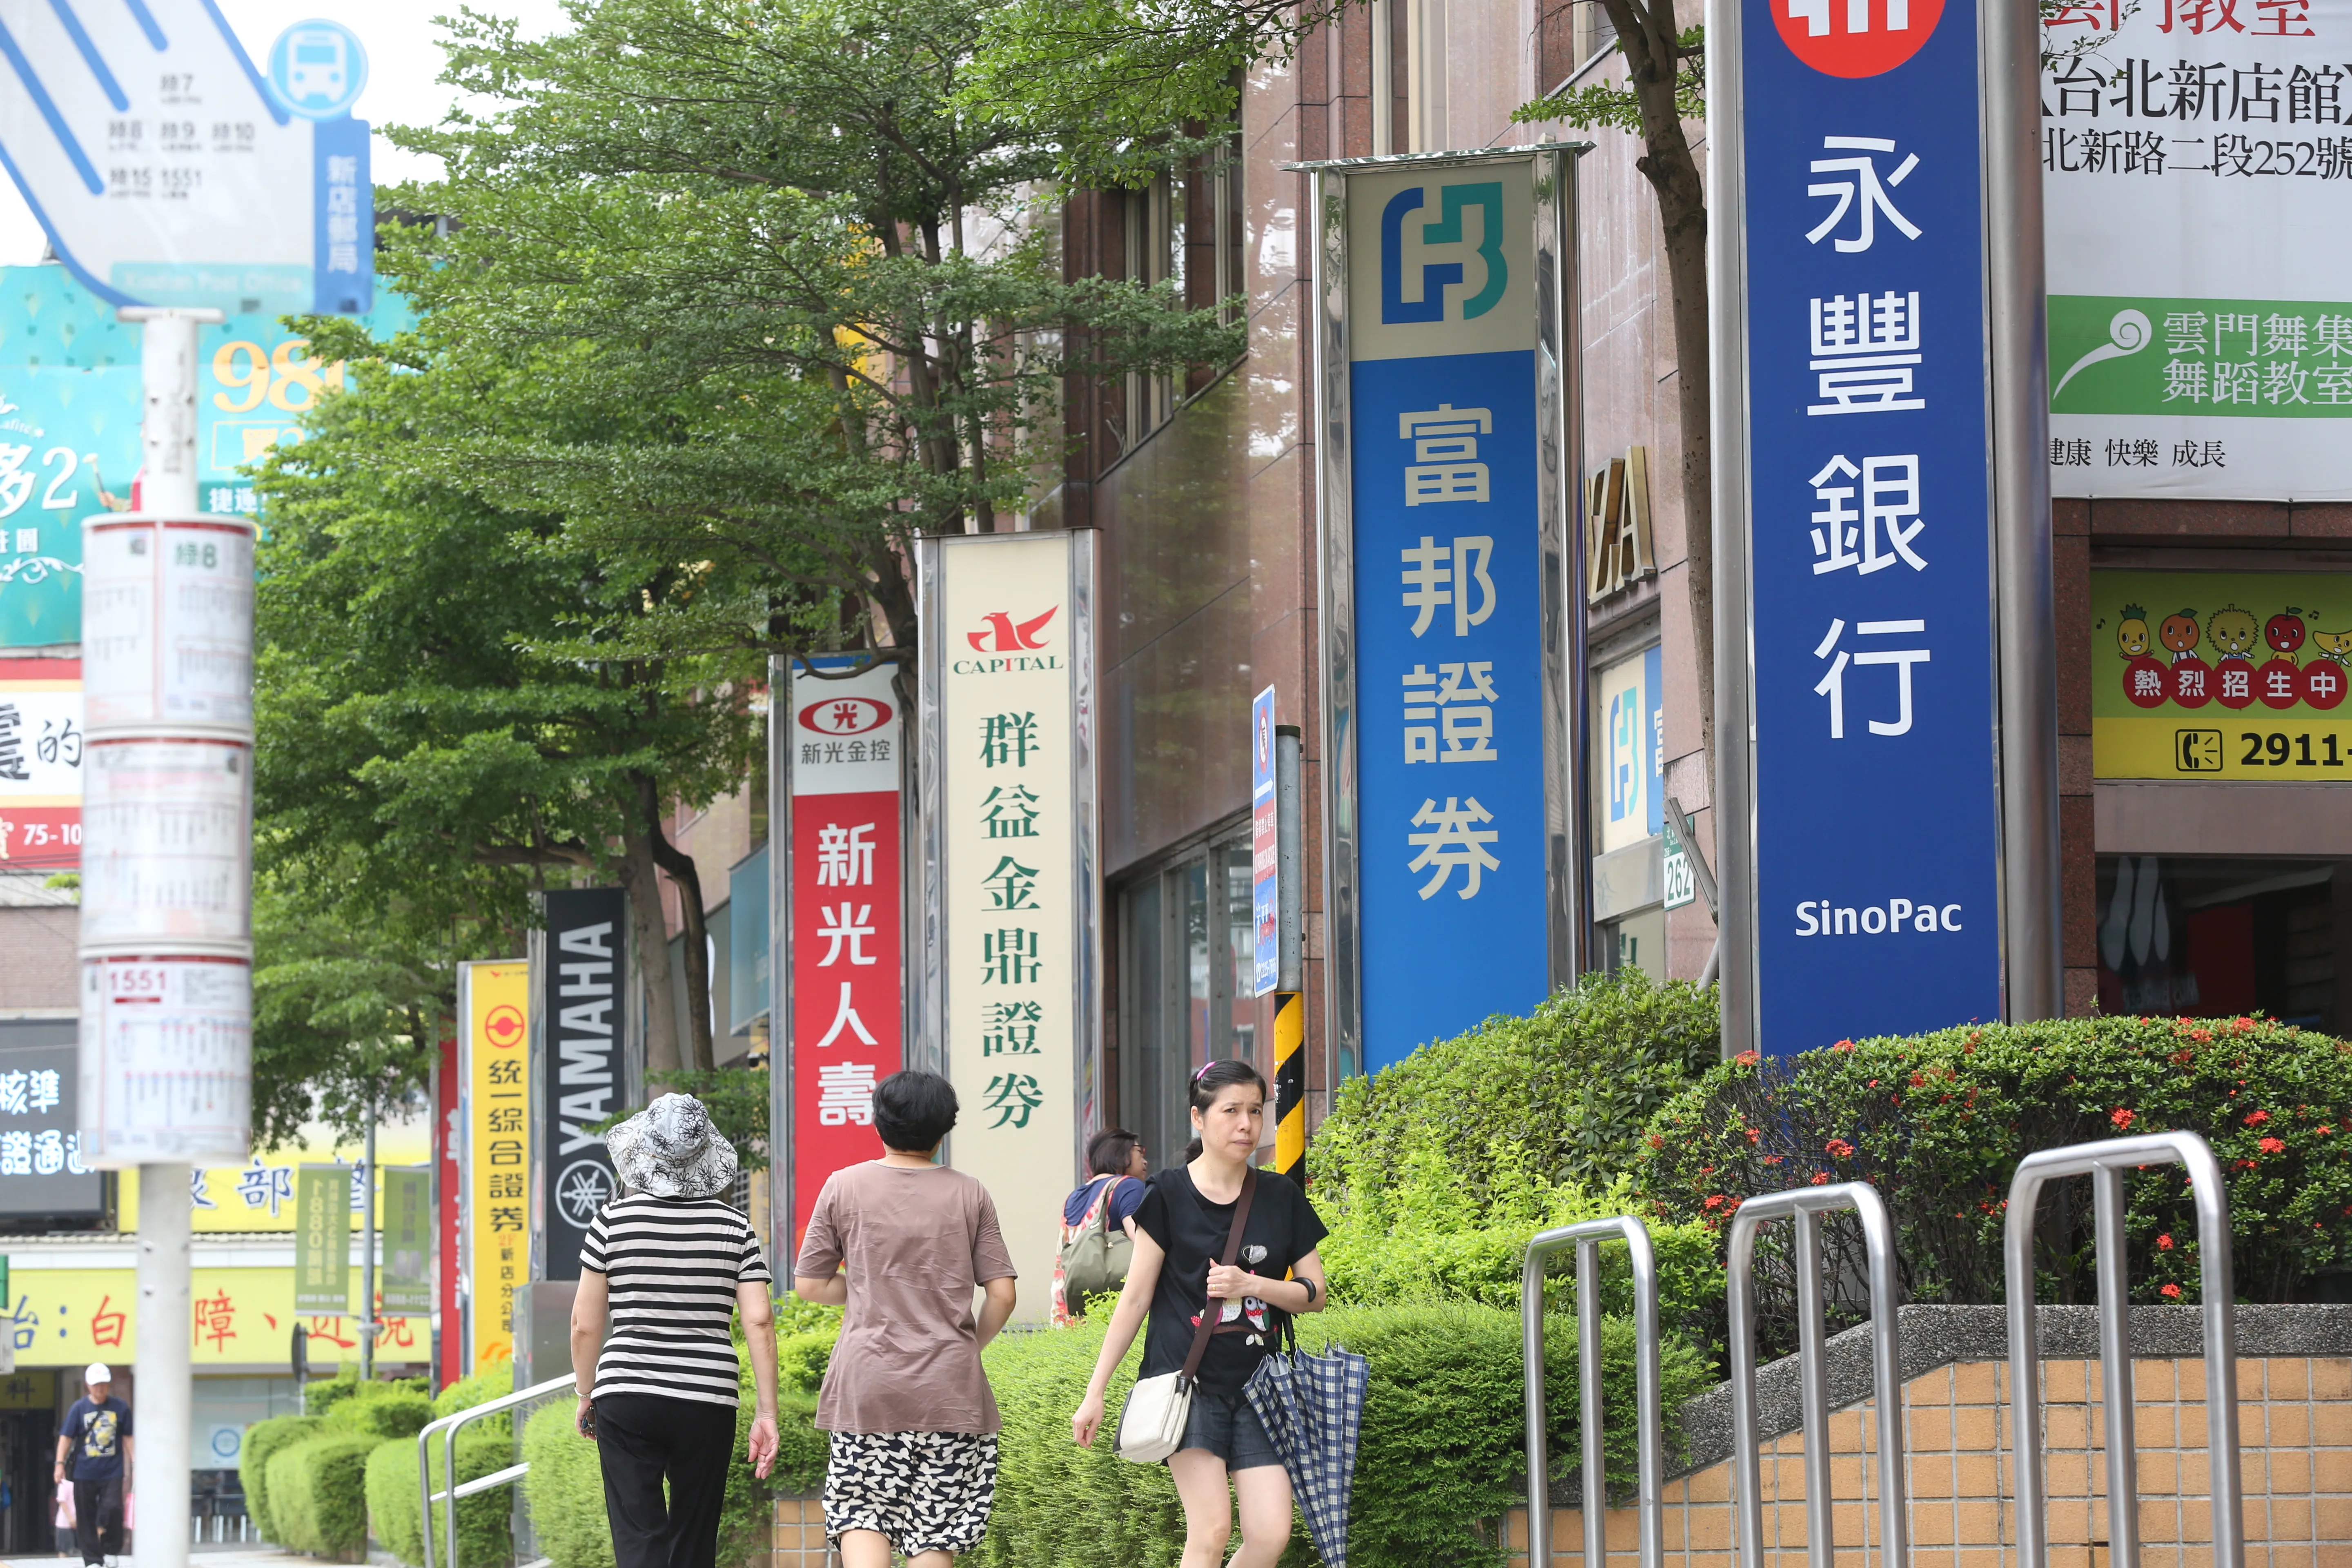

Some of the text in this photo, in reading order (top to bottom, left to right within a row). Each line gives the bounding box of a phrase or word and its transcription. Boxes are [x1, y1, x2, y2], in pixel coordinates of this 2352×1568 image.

[2043, 127, 2352, 180] 北新路二段252號
[2163, 310, 2352, 357] 雲門舞集
[2161, 358, 2352, 405] 舞蹈教室
[1805, 136, 1930, 739] 永豐銀行
[2105, 438, 2159, 467] 快樂
[2172, 439, 2226, 468] 成長
[953, 655, 1064, 675] CAPITAL
[1399, 403, 1501, 900] 富邦證券
[2134, 669, 2337, 698] 熱烈招生中
[802, 739, 891, 764] 新光金控
[1667, 858, 1690, 902] 262
[978, 710, 1044, 1129] 群益金鼎證券
[1795, 897, 1963, 937] SinoPac
[109, 968, 167, 991] 1551
[817, 822, 878, 1127] 新光人壽
[559, 921, 613, 1156] YAMAHA
[488, 1059, 523, 1233] 統一綜合證券
